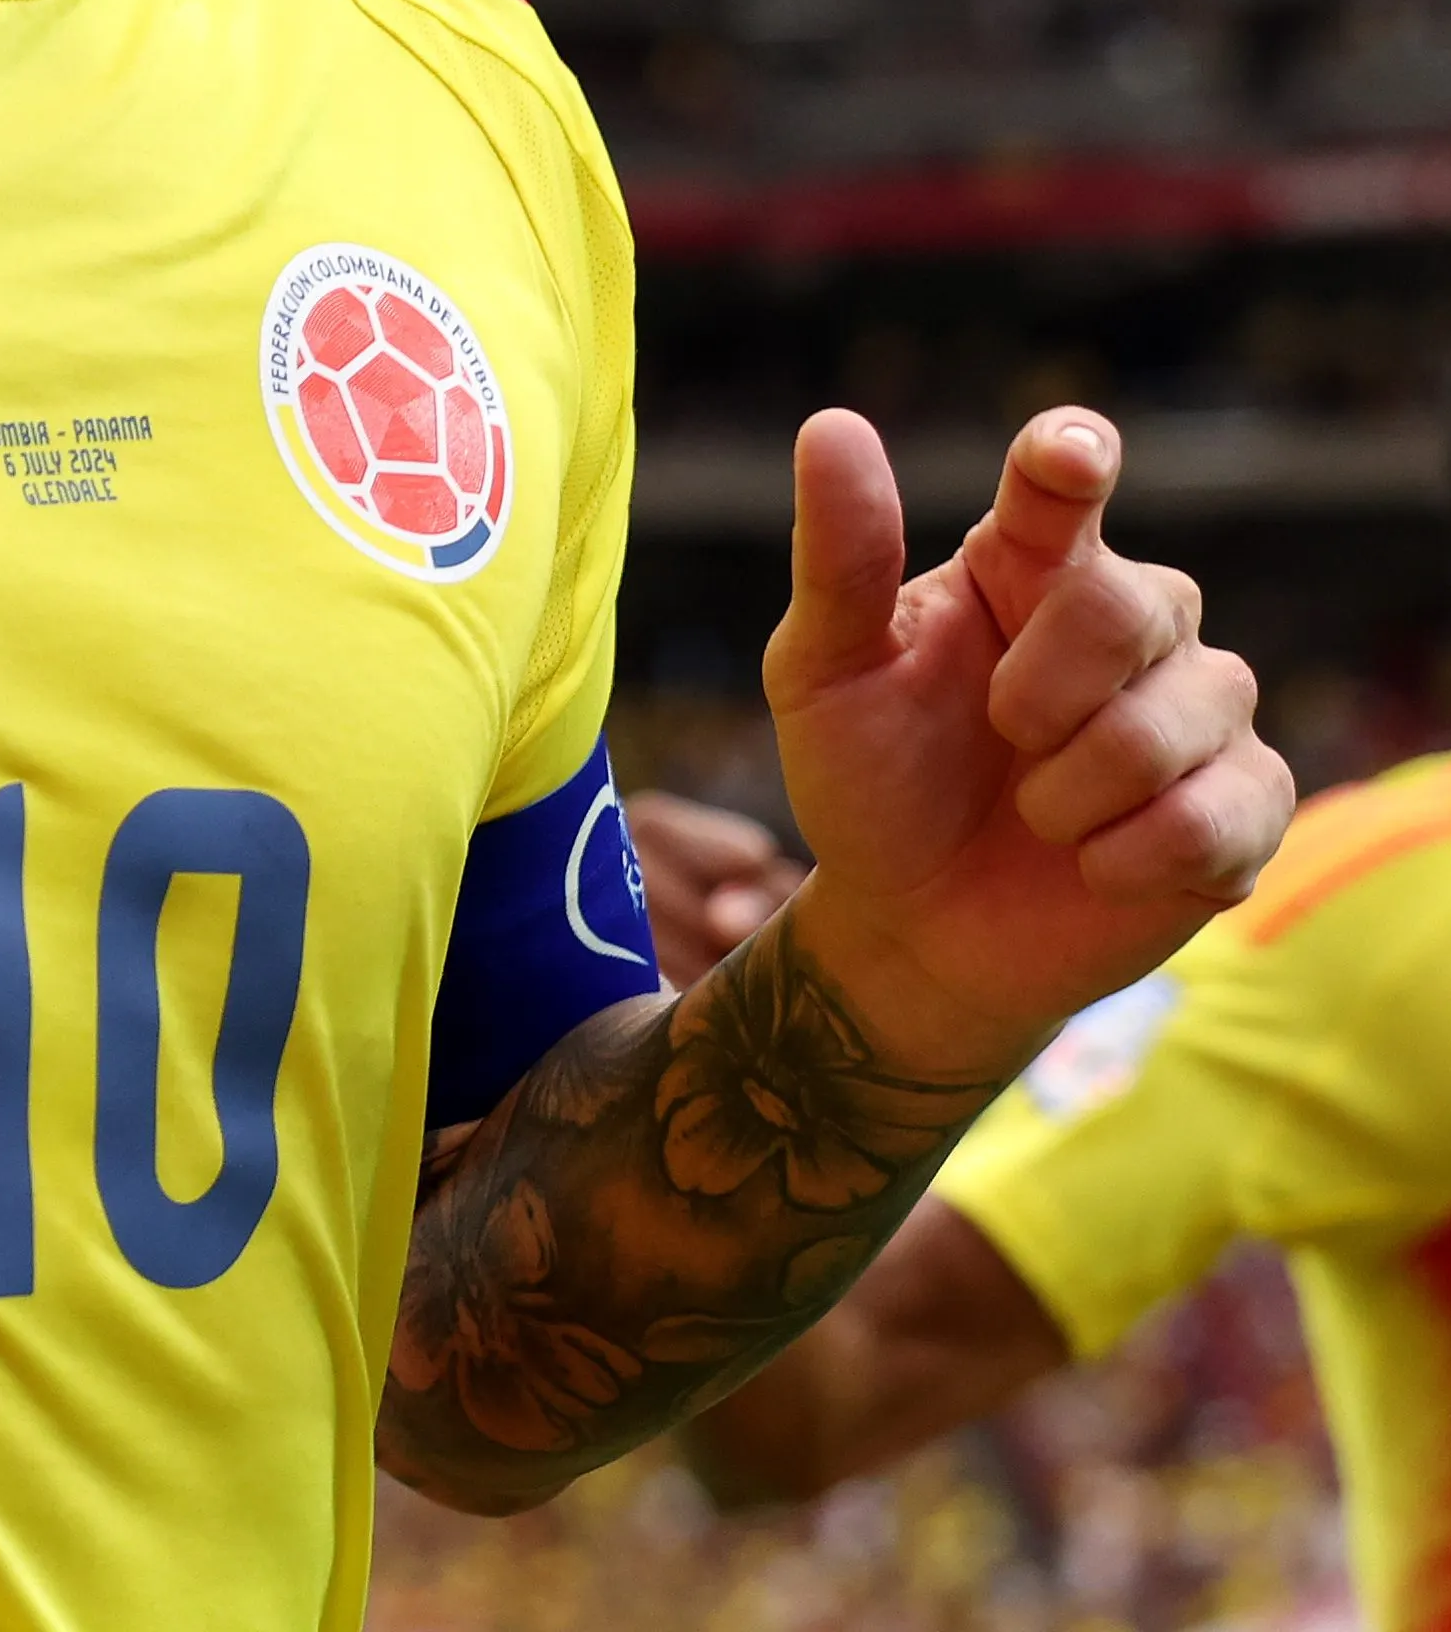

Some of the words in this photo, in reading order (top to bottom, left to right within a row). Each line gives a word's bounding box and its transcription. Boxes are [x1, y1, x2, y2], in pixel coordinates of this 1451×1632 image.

[309, 254, 425, 304] COLOMBIANA
[429, 296, 453, 326] DE
[72, 415, 153, 443] PANAMA
[3, 452, 17, 477] 6
[21, 449, 63, 476] JULY
[68, 448, 118, 473] 2024
[21, 477, 118, 506] GLENDALE
